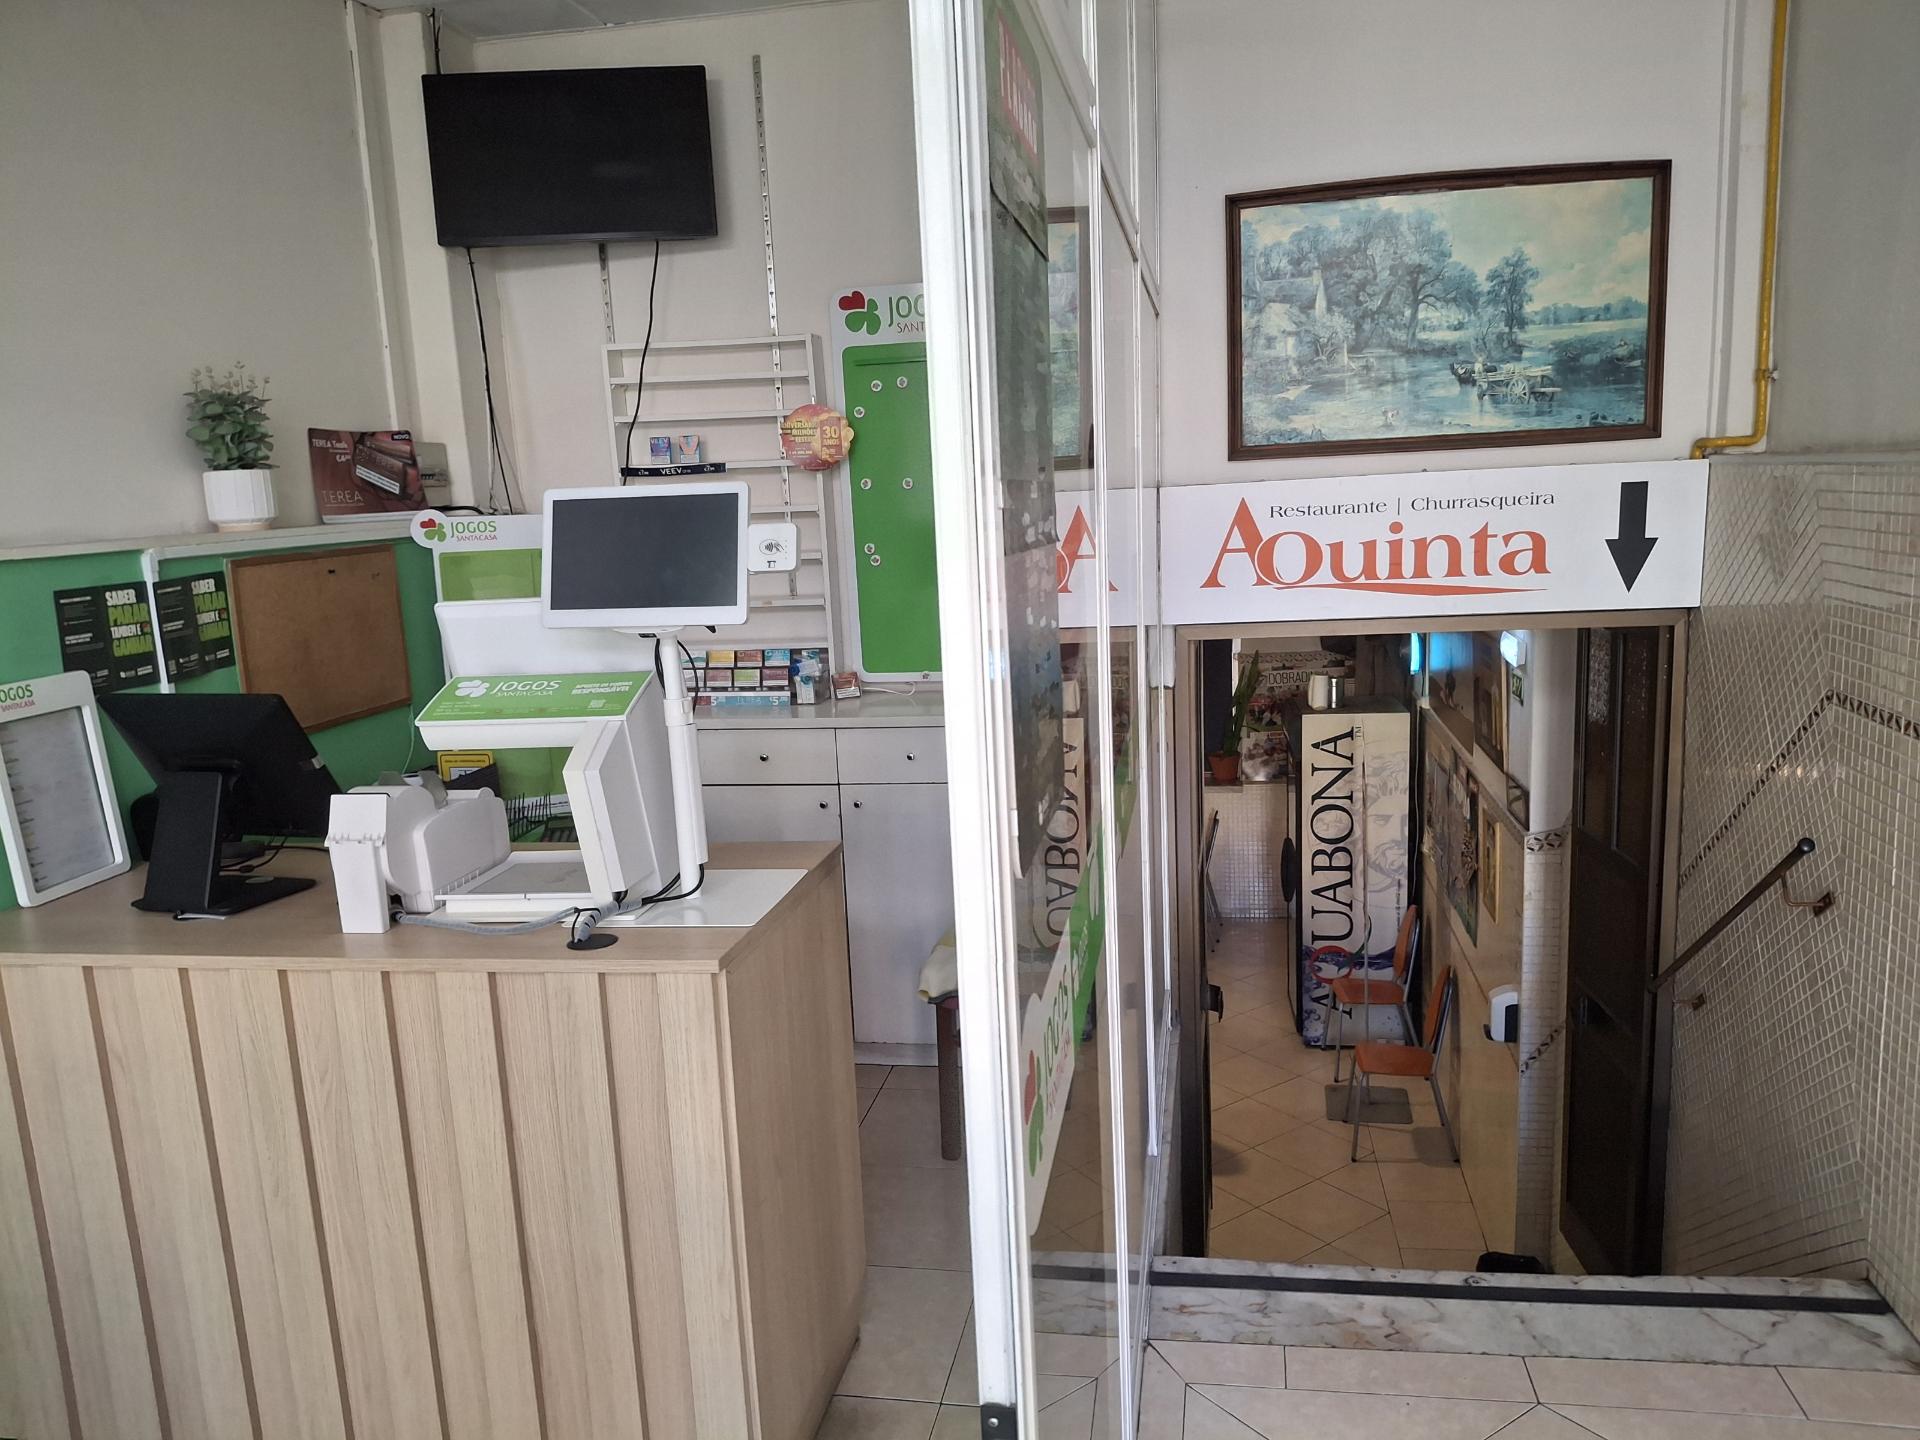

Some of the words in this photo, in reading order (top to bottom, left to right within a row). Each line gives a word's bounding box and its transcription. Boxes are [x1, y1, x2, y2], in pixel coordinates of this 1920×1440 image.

[896, 321, 925, 334] SANT
[823, 426, 840, 438] 30
[660, 467, 682, 475] VEEV
[322, 490, 364, 503] TEREA
[1270, 500, 1388, 519] Restaurante
[1410, 492, 1555, 512] Churrasqueira
[451, 521, 497, 538] JOGOS
[191, 578, 216, 595] SABER
[105, 589, 137, 606] SABER
[0, 684, 34, 701] OGOS
[489, 680, 562, 695] JOGOS
